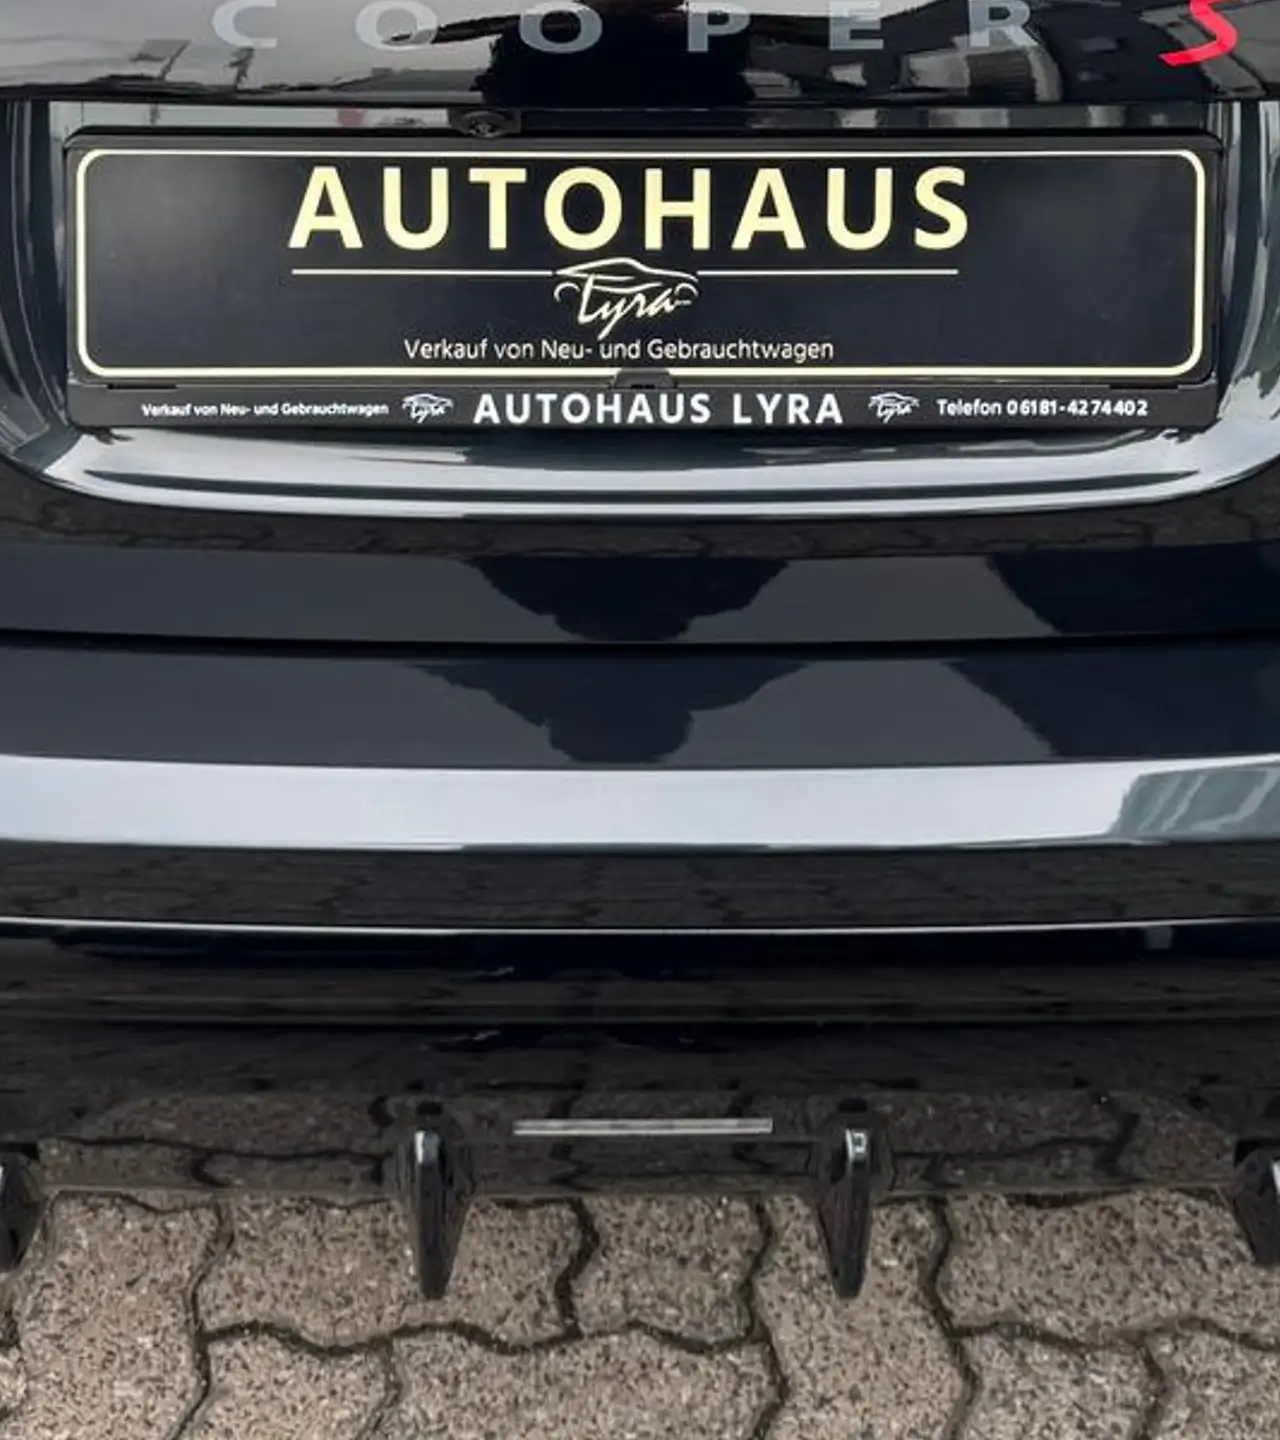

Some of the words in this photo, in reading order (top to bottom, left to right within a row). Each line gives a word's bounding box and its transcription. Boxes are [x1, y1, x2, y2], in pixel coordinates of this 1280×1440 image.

[287, 165, 969, 252] AUTOHAUS
[404, 338, 488, 360] Verkauf
[493, 342, 534, 360] von
[541, 339, 592, 360] Neu-
[597, 338, 641, 360] und
[647, 338, 834, 364] Gebrauchtwagen
[141, 402, 191, 417] Verkauf
[194, 404, 218, 416] von
[220, 403, 251, 416] Neu-
[253, 402, 278, 416] und
[281, 402, 389, 418] Gebrauchtwagen
[473, 392, 712, 425] AUTOHAUS
[732, 392, 843, 425] LYRA
[936, 398, 1002, 416] Telefon
[1006, 398, 1148, 417] 06181-4274402
